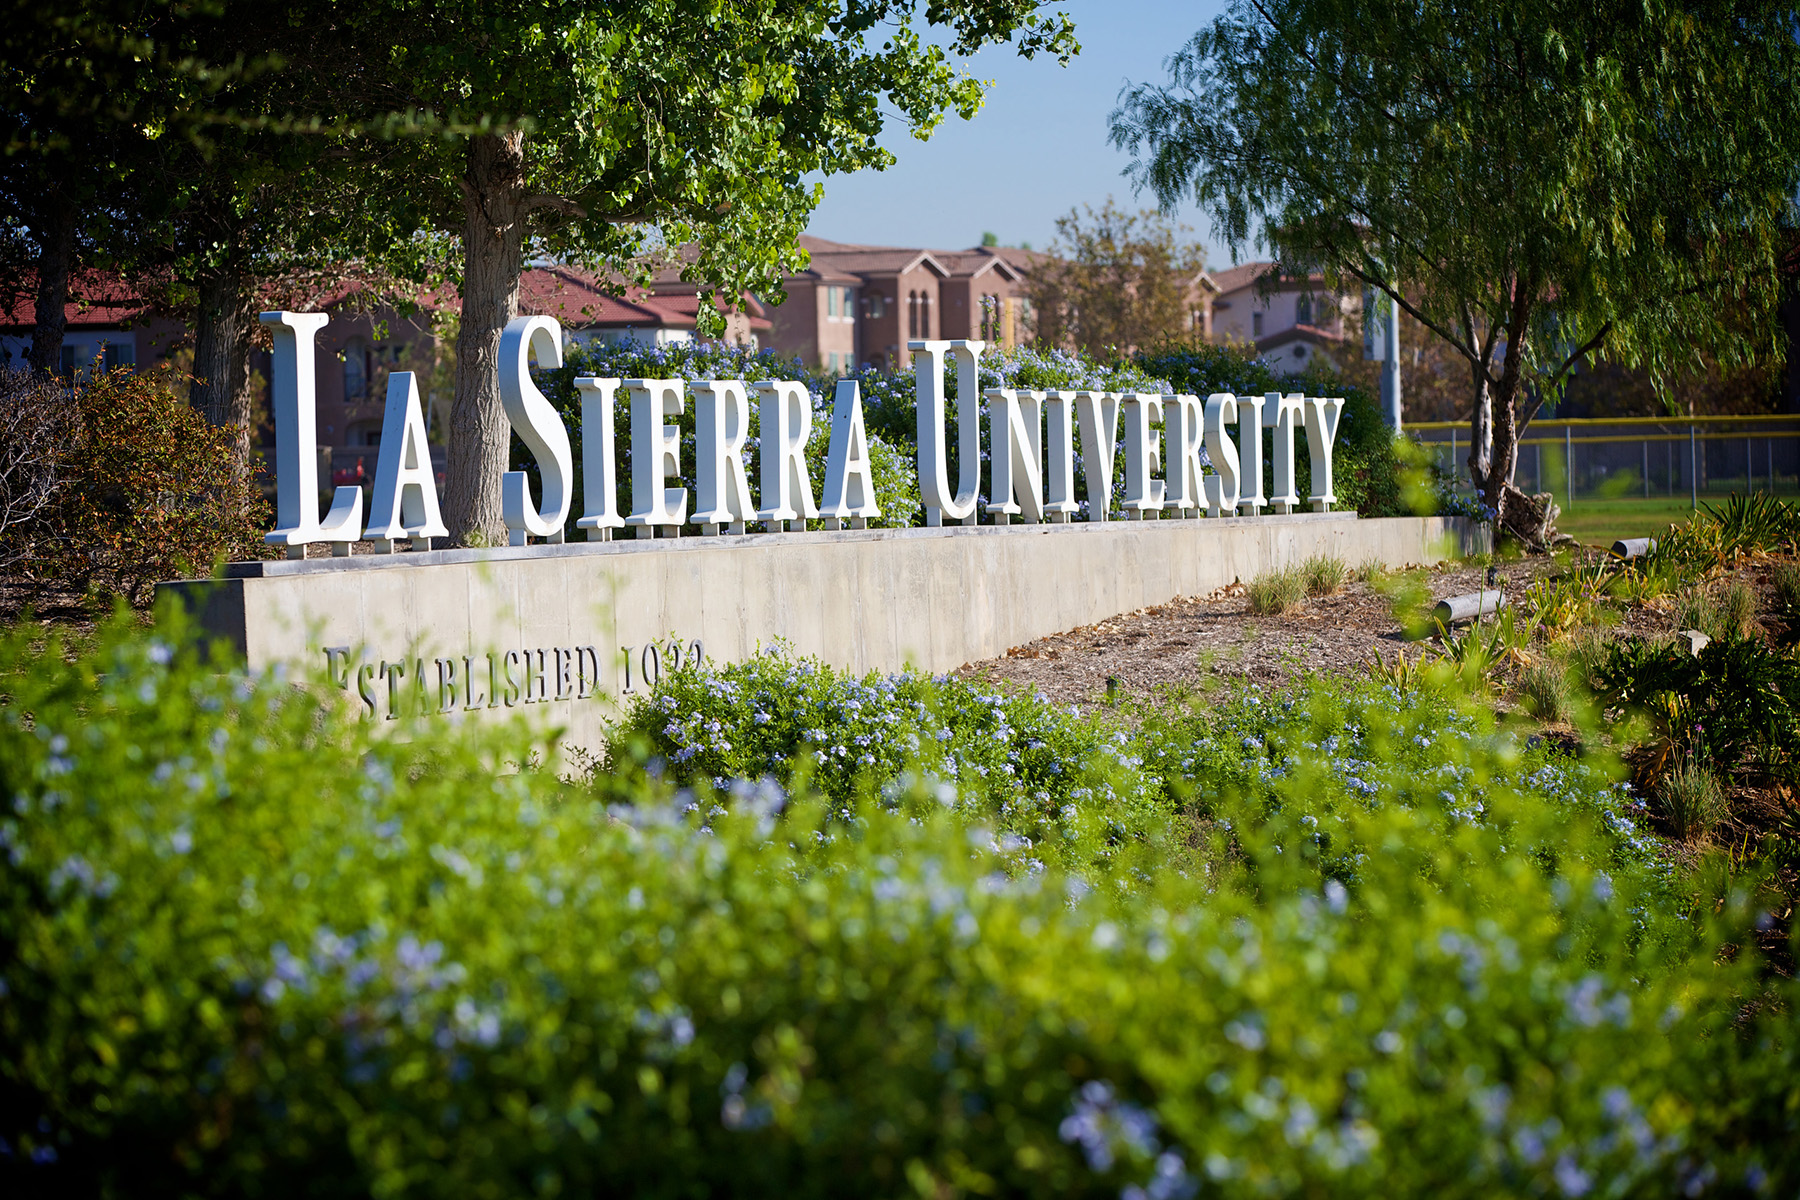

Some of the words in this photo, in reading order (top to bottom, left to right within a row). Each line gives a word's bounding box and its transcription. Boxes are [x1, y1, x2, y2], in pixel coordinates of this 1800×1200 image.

[259, 311, 449, 546] LA
[498, 315, 881, 540] SIERRA
[907, 340, 1346, 521] UNIVERSITY
[322, 645, 600, 723] ESTABLISHED
